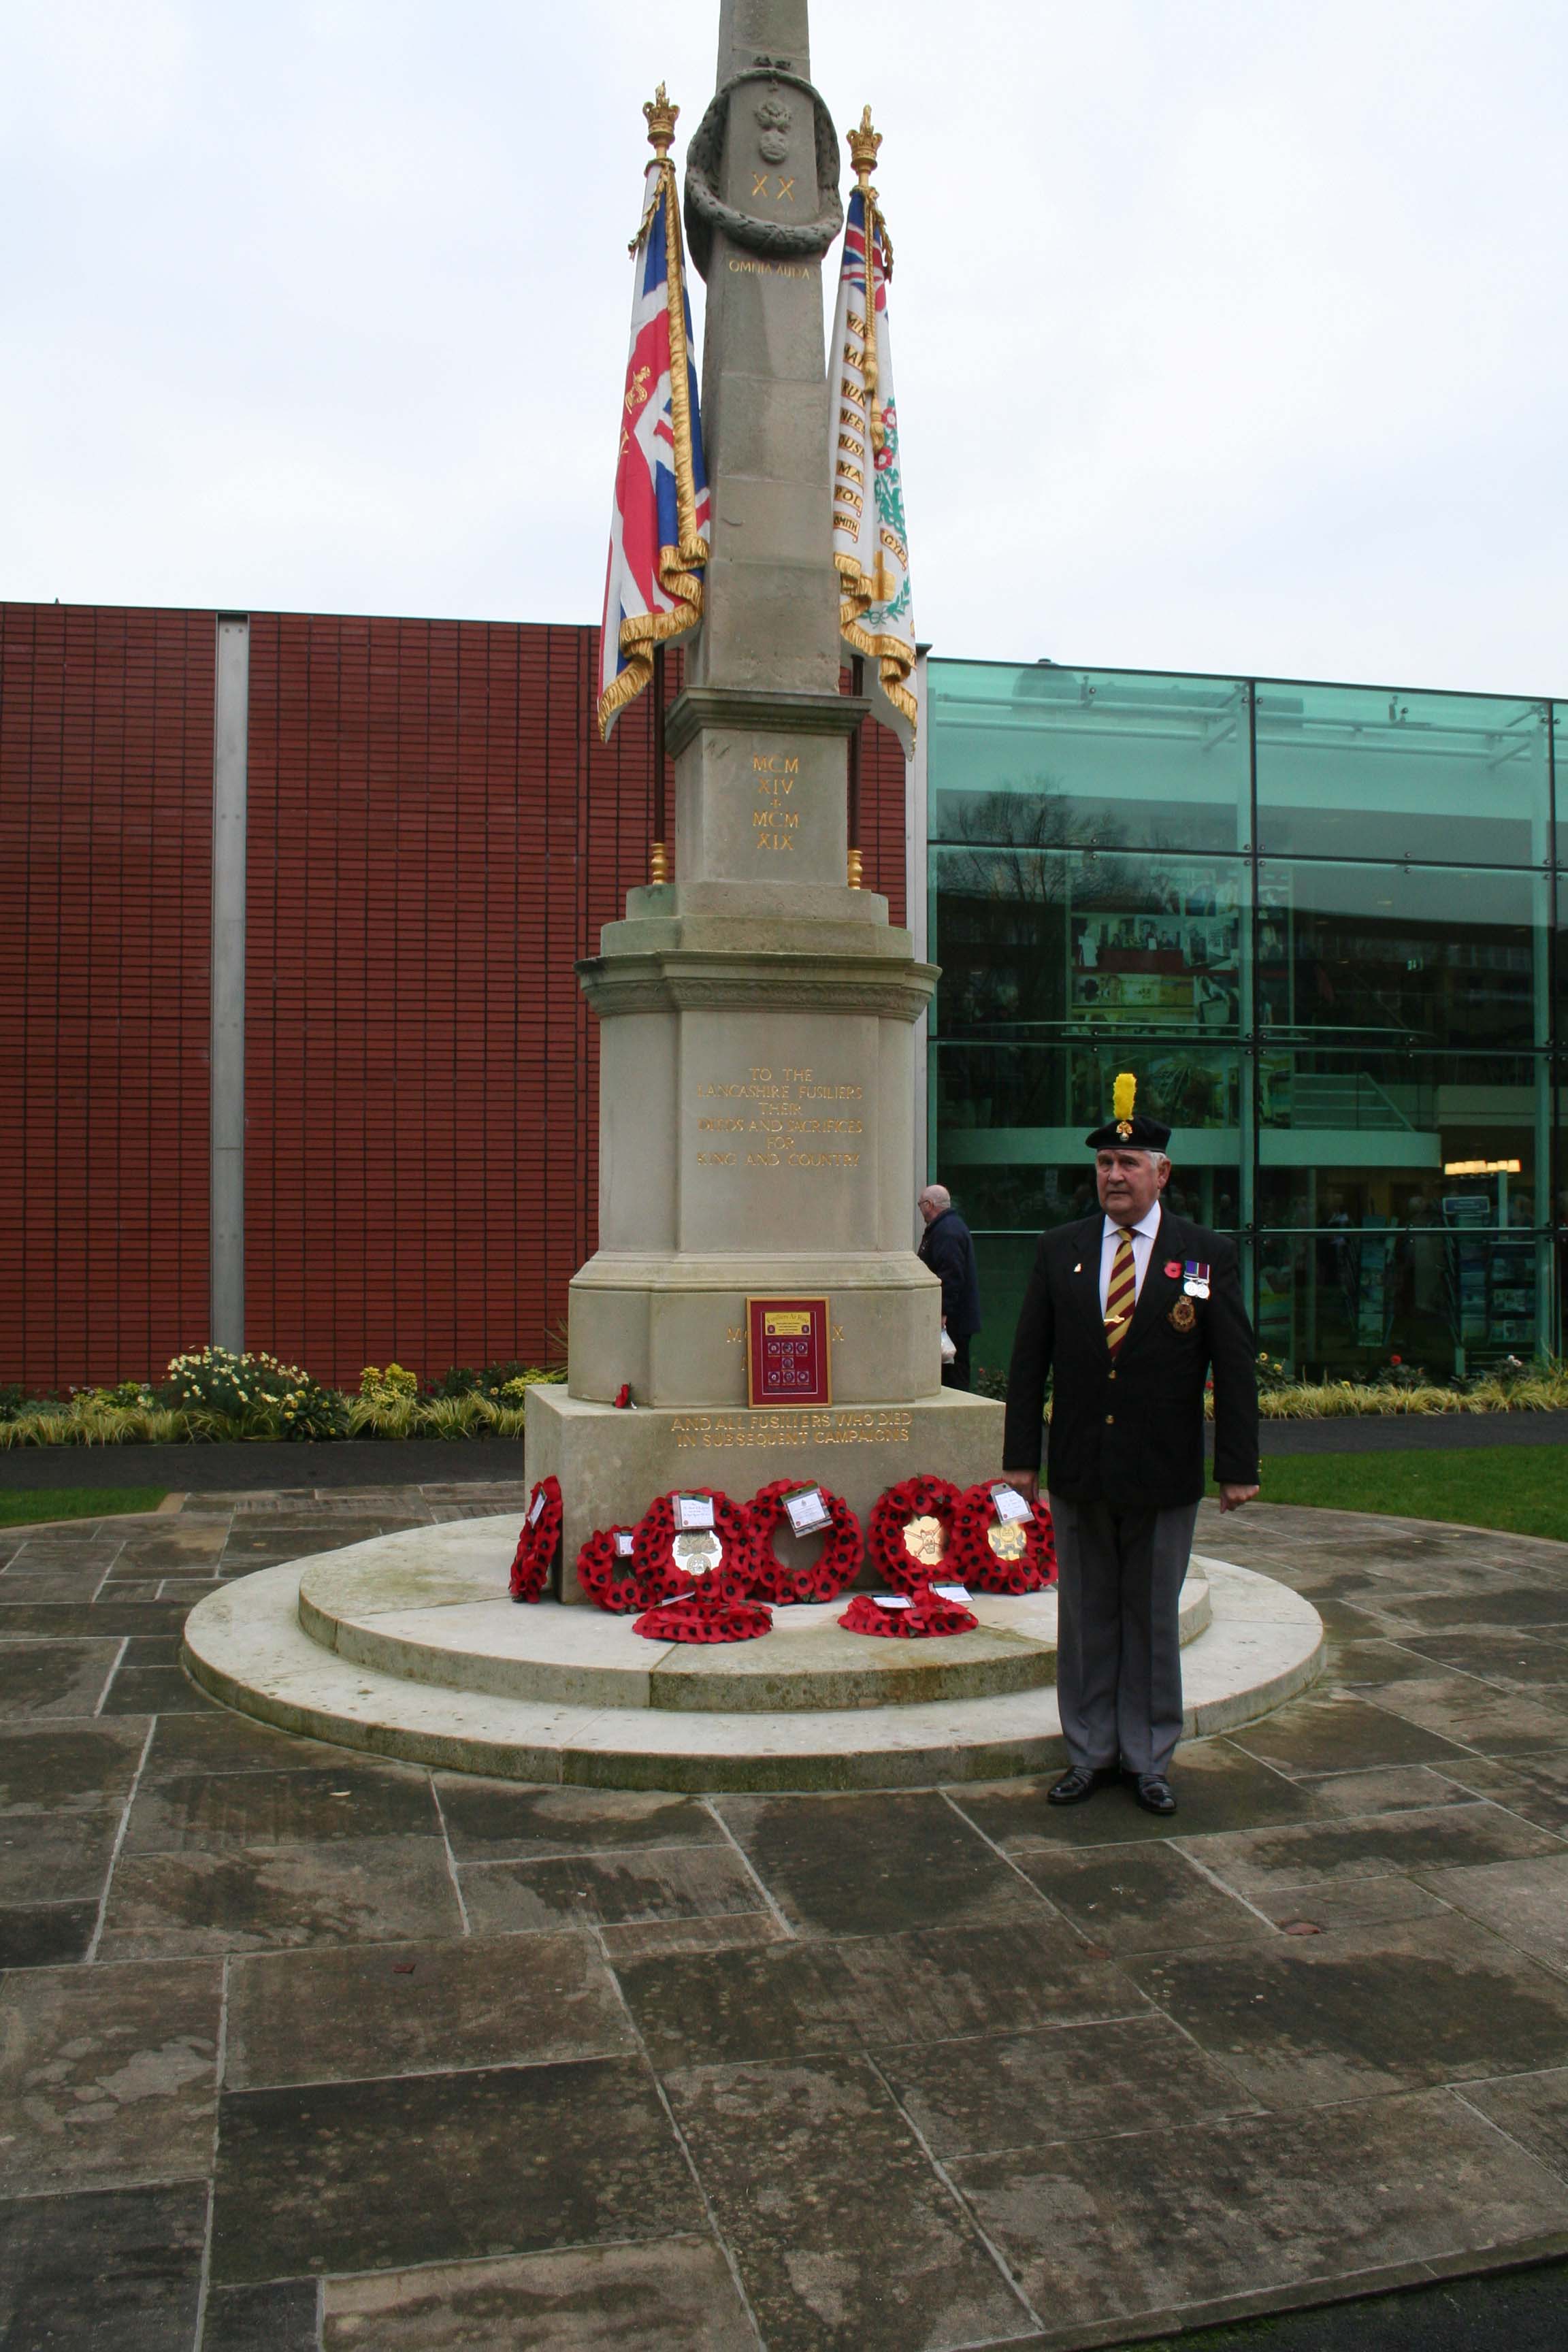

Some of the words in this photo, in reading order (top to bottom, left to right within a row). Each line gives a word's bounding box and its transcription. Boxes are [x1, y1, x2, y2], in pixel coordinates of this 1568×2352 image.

[729, 260, 772, 274] OMNIA
[753, 755, 798, 773] MCM
[757, 778, 794, 795] XIV
[753, 810, 799, 828] MCM
[757, 832, 794, 850] XIX
[749, 1068, 772, 1081] TO
[783, 1068, 813, 1081] THE
[697, 1083, 790, 1099] LANCASHIRE
[799, 1085, 863, 1100] FUSILIERS
[758, 1102, 802, 1115] THEIR
[697, 1117, 744, 1132] DEEDS
[749, 1120, 783, 1132] AND
[787, 1118, 862, 1133] SACRIFICES
[767, 1135, 794, 1149] FOR
[696, 1152, 736, 1166] KING
[746, 1152, 780, 1166] AND
[787, 1153, 860, 1166] COUNTRY
[670, 1416, 711, 1431] AND
[716, 1415, 745, 1431] ALL
[751, 1414, 831, 1428] FUSILIERS
[835, 1413, 875, 1426] WHO
[879, 1411, 913, 1425] DIED
[677, 1433, 697, 1447] IN
[702, 1431, 808, 1448] SUBSEQUENT
[815, 1428, 909, 1443] CAMPAIGNS
